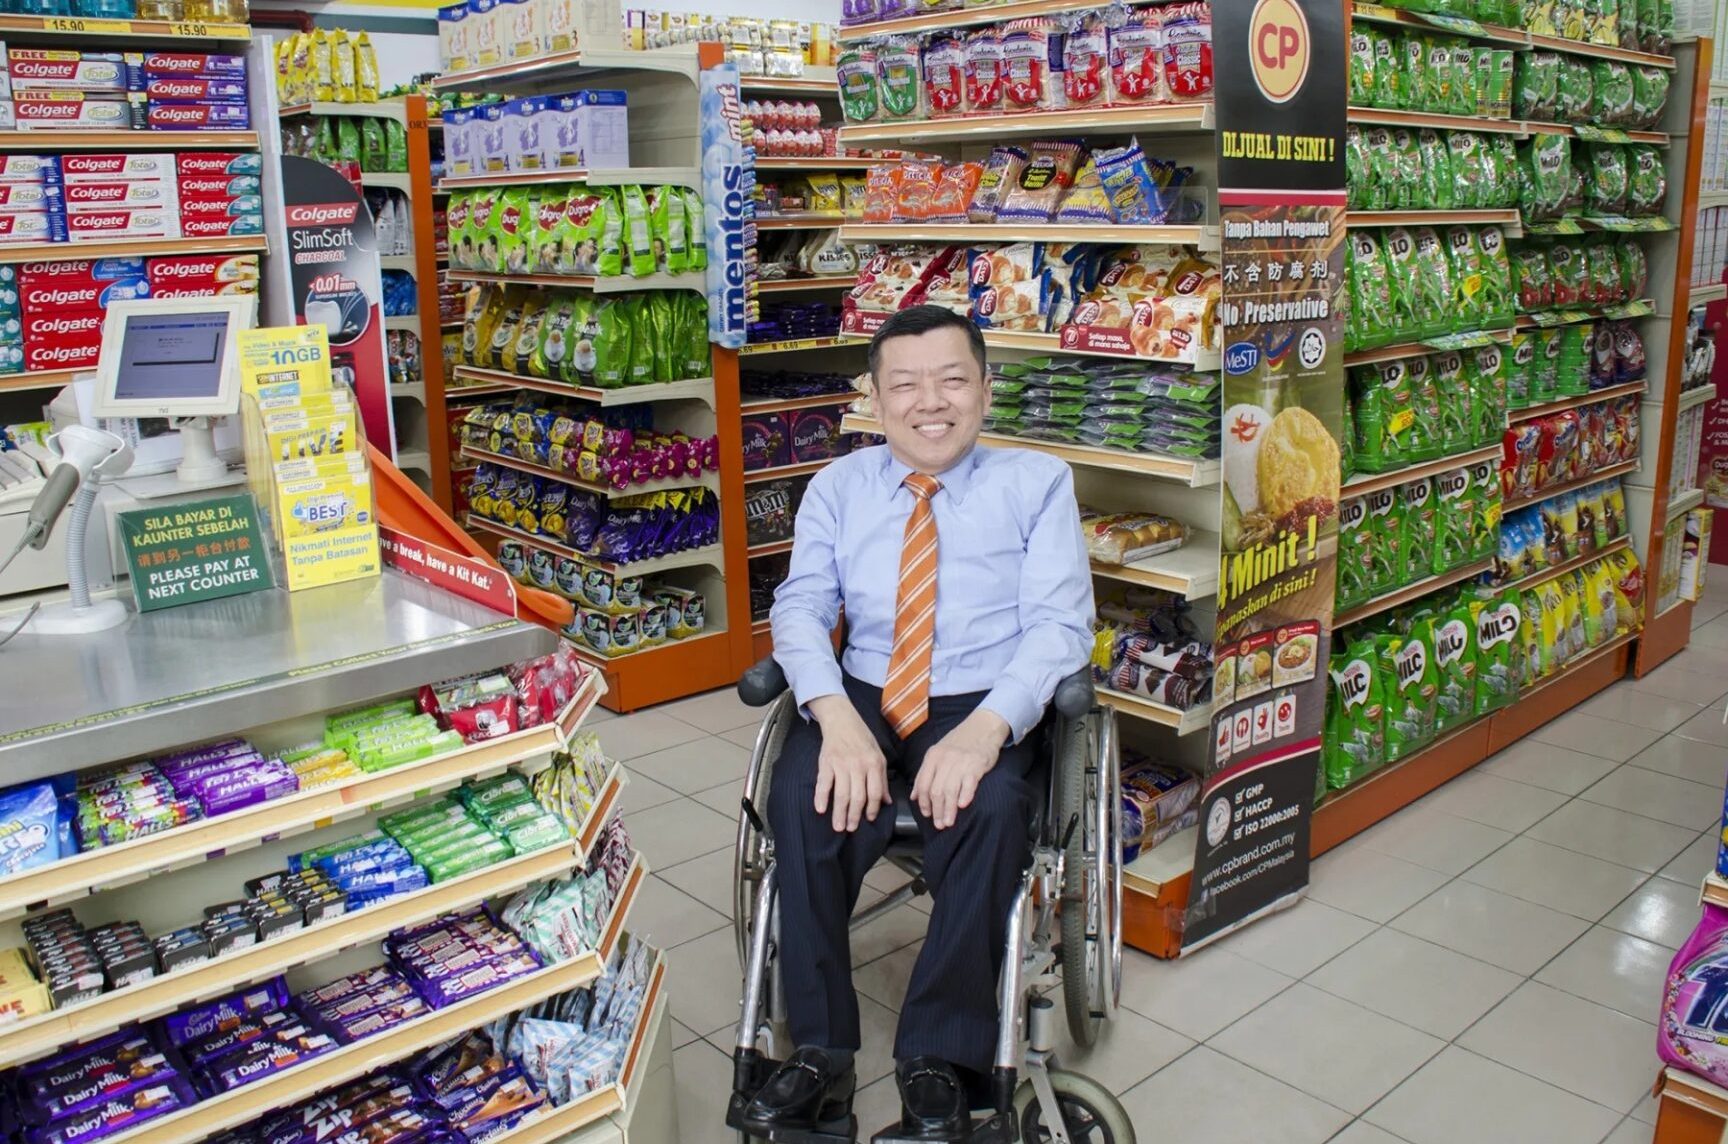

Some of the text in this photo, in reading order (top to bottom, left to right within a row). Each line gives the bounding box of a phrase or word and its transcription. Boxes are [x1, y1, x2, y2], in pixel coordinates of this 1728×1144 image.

[52, 20, 84, 31] 15.90
[178, 25, 207, 36] 15.90
[12, 51, 47, 59] FREE
[1257, 22, 1299, 70] CP
[14, 61, 74, 78] Colgate
[149, 56, 200, 70] Colgate
[17, 92, 51, 100] FREE
[151, 81, 202, 95] Colgate
[19, 103, 77, 119] Colgate
[153, 107, 203, 121] Colgate
[716, 84, 742, 141] mint
[1222, 131, 1274, 159] DIJUAL
[1277, 136, 1292, 160] DI
[1293, 137, 1326, 161] SINI
[68, 158, 120, 172] Colgate
[182, 159, 227, 171] Colgate
[71, 187, 122, 201] Colgate
[182, 180, 227, 192] Colgate
[184, 200, 228, 212] Colgate
[291, 205, 355, 223] Colgate
[73, 215, 124, 229] Colgate
[185, 220, 229, 233] Colgate
[1224, 220, 1330, 239] Tanpa Bahan Pengawet
[293, 228, 353, 250] SlimSoft
[295, 251, 346, 265] CHARCOAL
[719, 165, 744, 333] mentos
[154, 262, 215, 278] Colgate
[1224, 260, 1328, 284] 不含防腐剂
[29, 288, 97, 306] Colgate
[1224, 297, 1329, 326] No Preservative
[31, 317, 99, 334] Colgate
[32, 345, 99, 362] Colgate
[795, 433, 812, 447] Dairy
[144, 506, 232, 531] SILA BAYAR DI
[309, 502, 347, 521] BEST
[133, 517, 249, 547] KAUNTER SEBELAH
[290, 532, 373, 553] Nikmati Internet
[292, 546, 369, 566] Tanpa Batasan
[400, 542, 426, 567] break,
[427, 552, 447, 573] have
[456, 566, 470, 583] Kit
[150, 555, 251, 585] PLEASE PAY AT
[148, 568, 260, 600] NEXT COUNTER
[1479, 615, 1517, 644] MILO
[1245, 783, 1265, 799] GMP
[1245, 797, 1273, 818] HACCP
[1245, 820, 1259, 836] ISO
[184, 1003, 241, 1039] Dairy Milk
[205, 1030, 234, 1052] Dairy
[238, 1044, 297, 1076] Dairy Milk
[50, 1054, 114, 1087] Dairy Milk
[64, 1070, 129, 1106] Dairy Milk
[66, 1101, 134, 1139] Dairy Milk
[308, 1108, 353, 1143] ZIP
